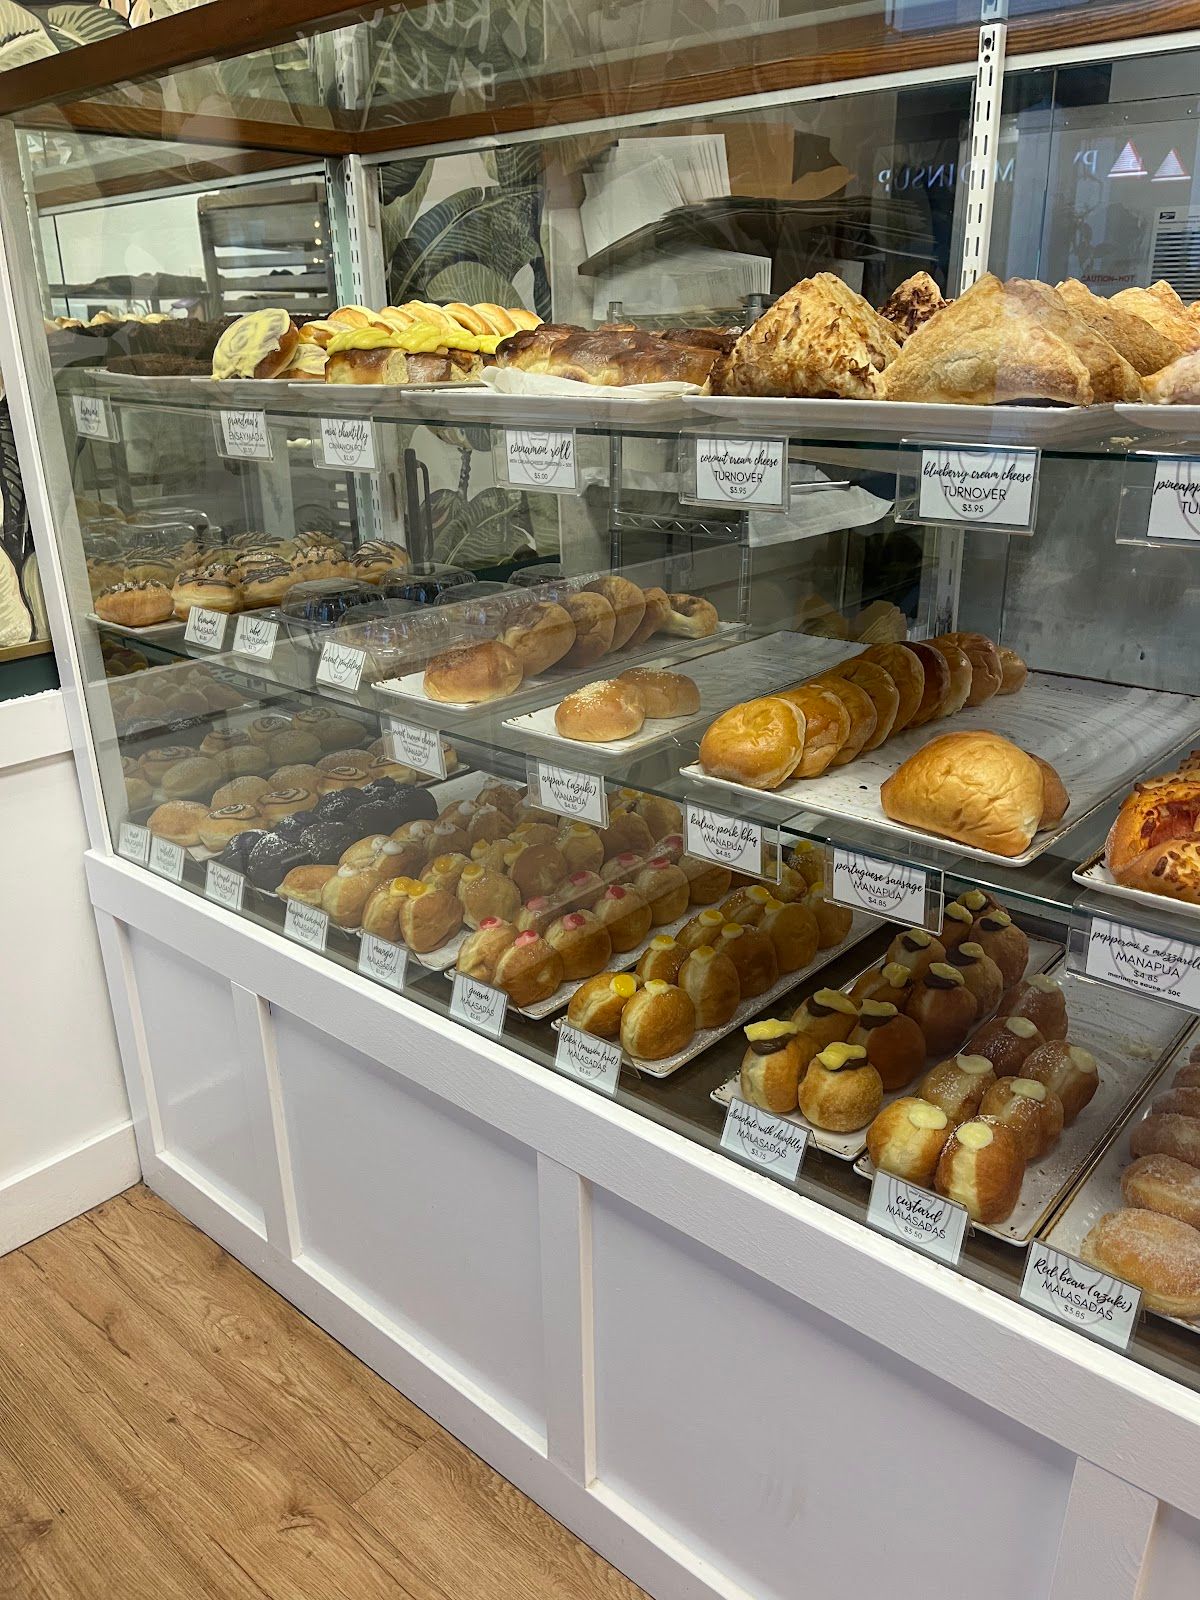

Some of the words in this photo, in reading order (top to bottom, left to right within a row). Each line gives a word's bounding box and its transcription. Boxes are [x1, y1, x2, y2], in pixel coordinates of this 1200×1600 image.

[228, 431, 265, 442] ENSAYMADA
[510, 442, 549, 455] cinnamon
[550, 440, 572, 460] roll
[700, 452, 728, 465] coconut
[730, 456, 752, 465] cream
[754, 449, 778, 468] cheese
[534, 472, 548, 480] $5.00
[714, 470, 763, 483] TURNOVER
[923, 461, 970, 484] blueberry
[971, 469, 999, 480] cream
[1001, 463, 1032, 483] cheese
[729, 486, 747, 495] $3.95
[943, 485, 1007, 501] TURNOVER
[961, 503, 984, 513] $3.95
[1180, 501, 1200, 514] TU
[321, 648, 340, 665] bread
[336, 657, 362, 676] pudding
[566, 778, 597, 797] (azuki)
[554, 790, 587, 806] MANAPUA
[690, 813, 715, 831] kalua
[716, 825, 739, 838] pork
[703, 833, 743, 852] MANAPUA
[715, 848, 732, 858] $4.85
[834, 861, 884, 882] portuguese
[885, 876, 923, 895] sausage
[853, 880, 903, 902] MANAPUA
[868, 896, 887, 908] $4.85
[1091, 930, 1141, 950] pepperoni
[1142, 944, 1149, 953] &
[373, 945, 394, 963] mango
[367, 955, 397, 974] MALASADAS
[1115, 951, 1181, 978] MANAPUA
[1107, 971, 1139, 985] marinara
[1139, 981, 1161, 992] sauce
[1133, 969, 1159, 983] $4.85
[467, 987, 490, 1002] guava
[462, 997, 495, 1017] MALASADAS
[566, 1048, 607, 1073] MALASADAS
[577, 1040, 601, 1057] (passion
[600, 1051, 619, 1066] fruit)
[728, 1108, 758, 1129] chocolate
[757, 1125, 775, 1137] with
[774, 1129, 803, 1154] chantilly
[736, 1128, 787, 1159] MALASADAS
[751, 1148, 767, 1160] $3.75
[895, 1195, 943, 1223] custard
[885, 1203, 946, 1240] MALASADAS
[903, 1225, 923, 1240] $3.50
[1033, 1257, 1058, 1278] Red
[1059, 1267, 1085, 1290] bean
[1087, 1284, 1133, 1313] (azuki)
[1041, 1280, 1114, 1321] MALASADAS
[1063, 1304, 1086, 1320] $3.85
